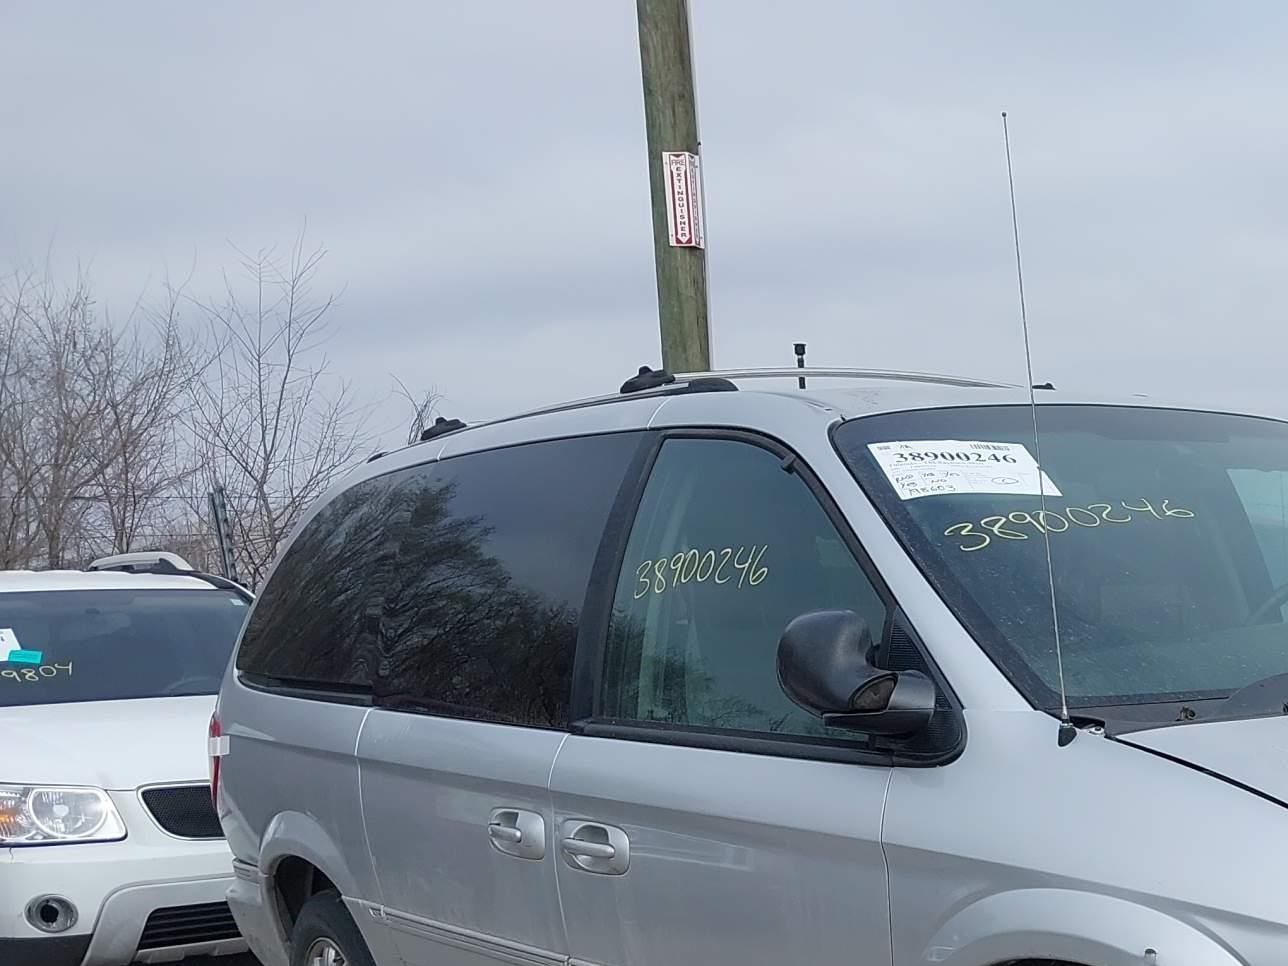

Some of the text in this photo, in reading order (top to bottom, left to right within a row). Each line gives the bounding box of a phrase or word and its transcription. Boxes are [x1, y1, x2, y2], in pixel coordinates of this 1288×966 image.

[675, 166, 688, 238] EXTINGUISHER
[892, 451, 1018, 464] 38900246
[943, 498, 1195, 552] 38900246
[633, 544, 768, 599] 38900246
